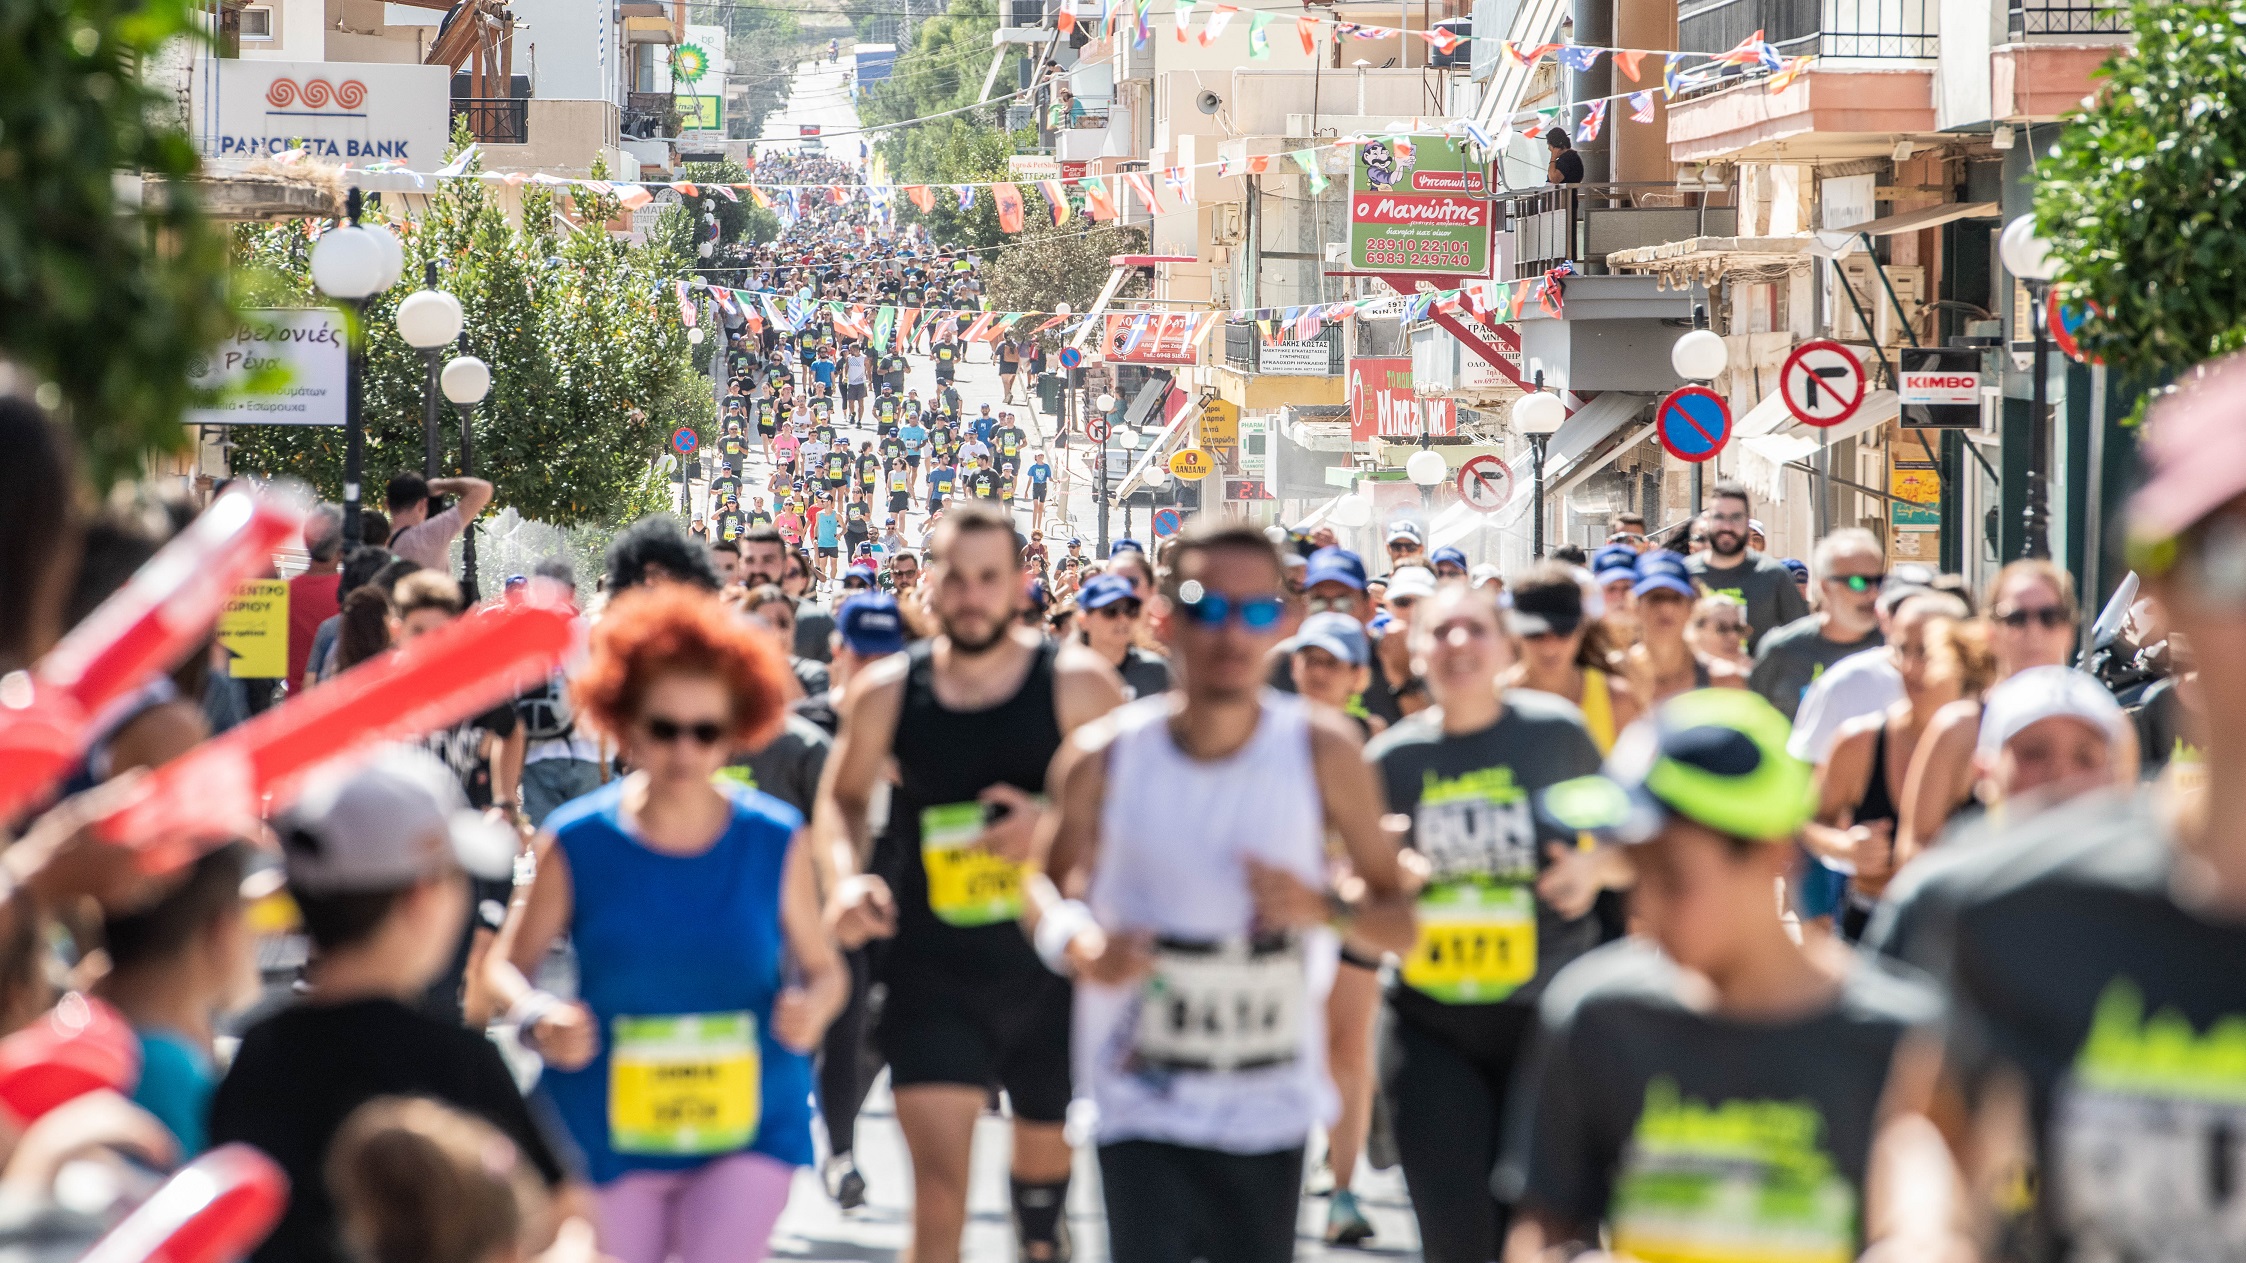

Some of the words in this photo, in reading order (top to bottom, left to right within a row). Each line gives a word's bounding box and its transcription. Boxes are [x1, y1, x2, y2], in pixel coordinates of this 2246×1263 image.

[702, 35, 715, 44] bp
[347, 140, 409, 158] BANK
[1374, 198, 1481, 226] Μανώλης
[1366, 238, 1416, 252] 28910
[1420, 240, 1469, 253] 22101
[1366, 252, 1405, 265] 6983
[1410, 253, 1471, 266] 249740
[225, 350, 281, 371] Ρένα
[1907, 376, 1976, 389] KIMBO
[247, 401, 306, 413] Εσώρουχα
[1175, 465, 1207, 474] ΔΑΝΔΑΛΗ
